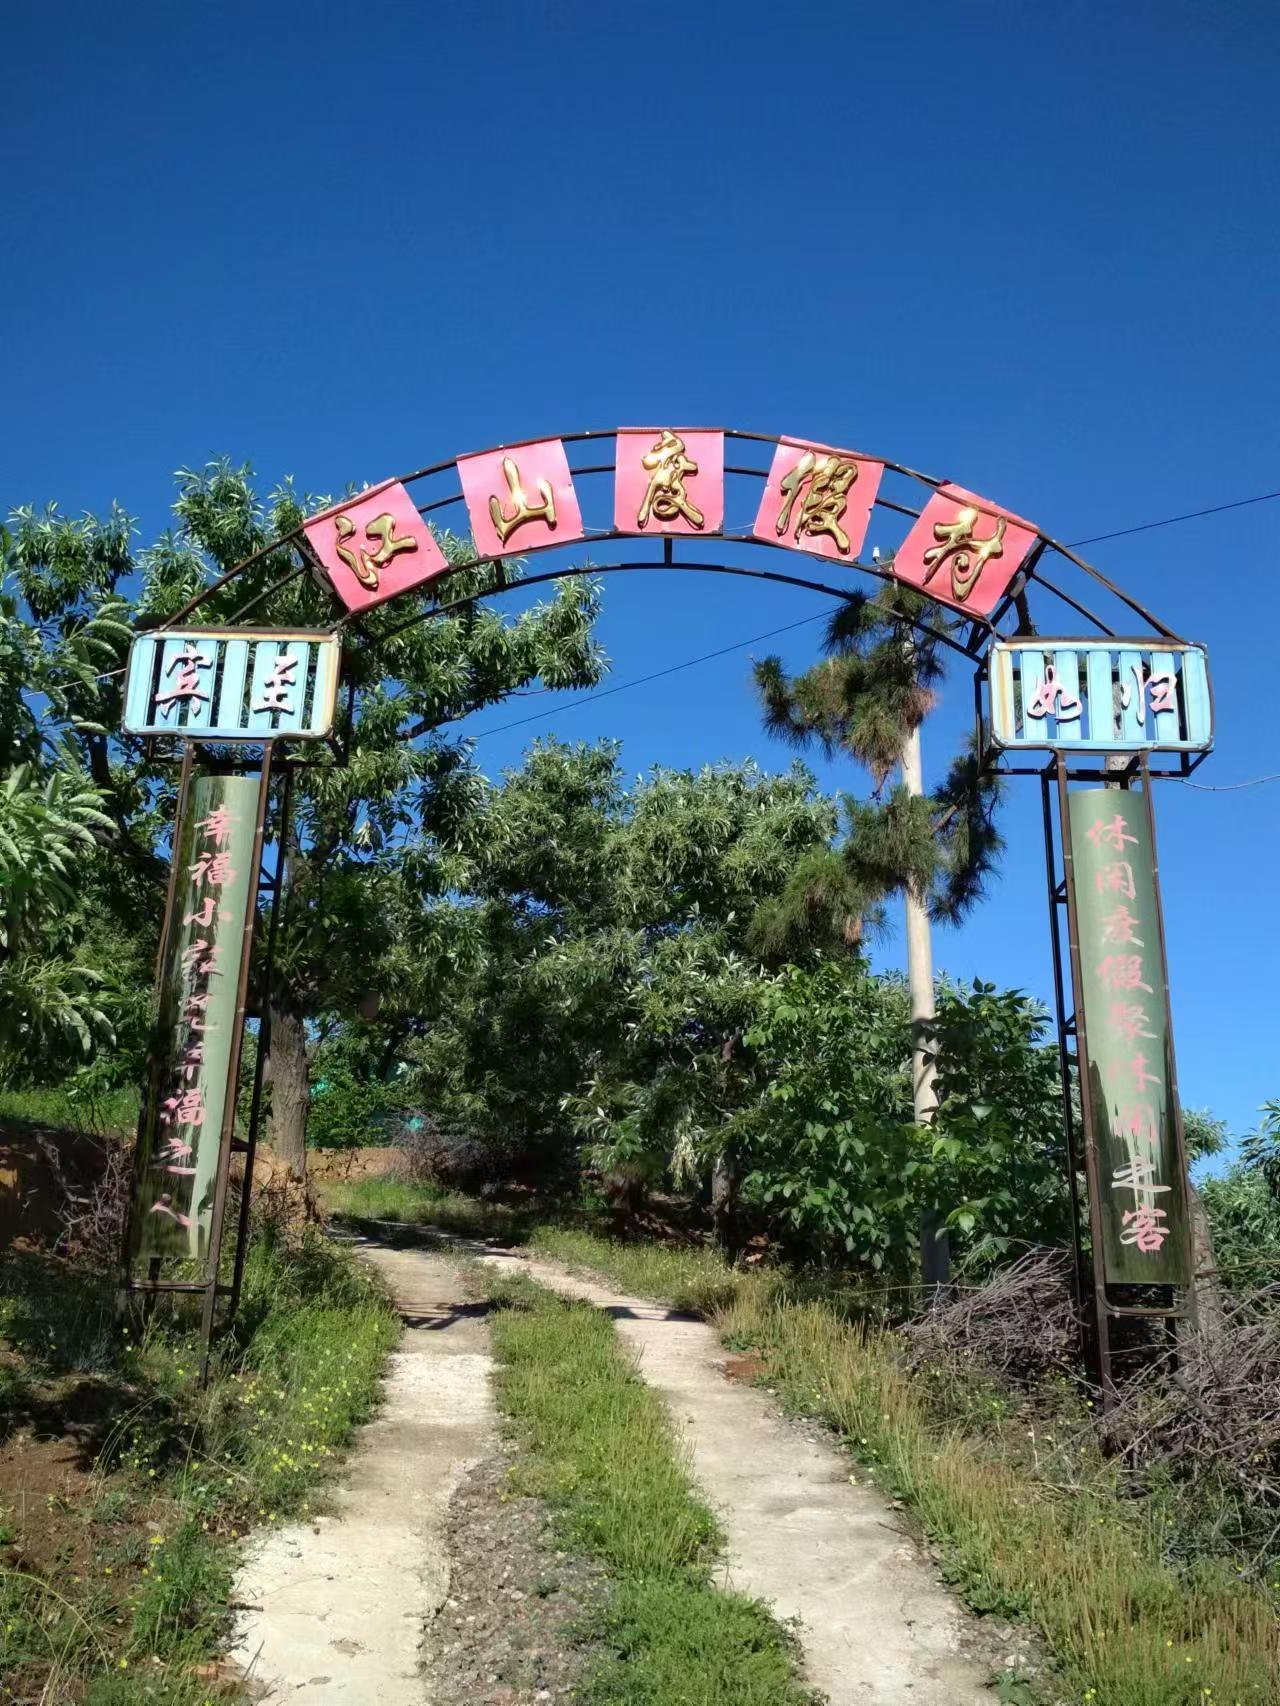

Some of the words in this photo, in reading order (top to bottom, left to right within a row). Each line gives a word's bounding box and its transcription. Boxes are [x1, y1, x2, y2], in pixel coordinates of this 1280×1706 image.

[335, 430, 1006, 602] 江山度假村
[1027, 664, 1178, 727] 如归
